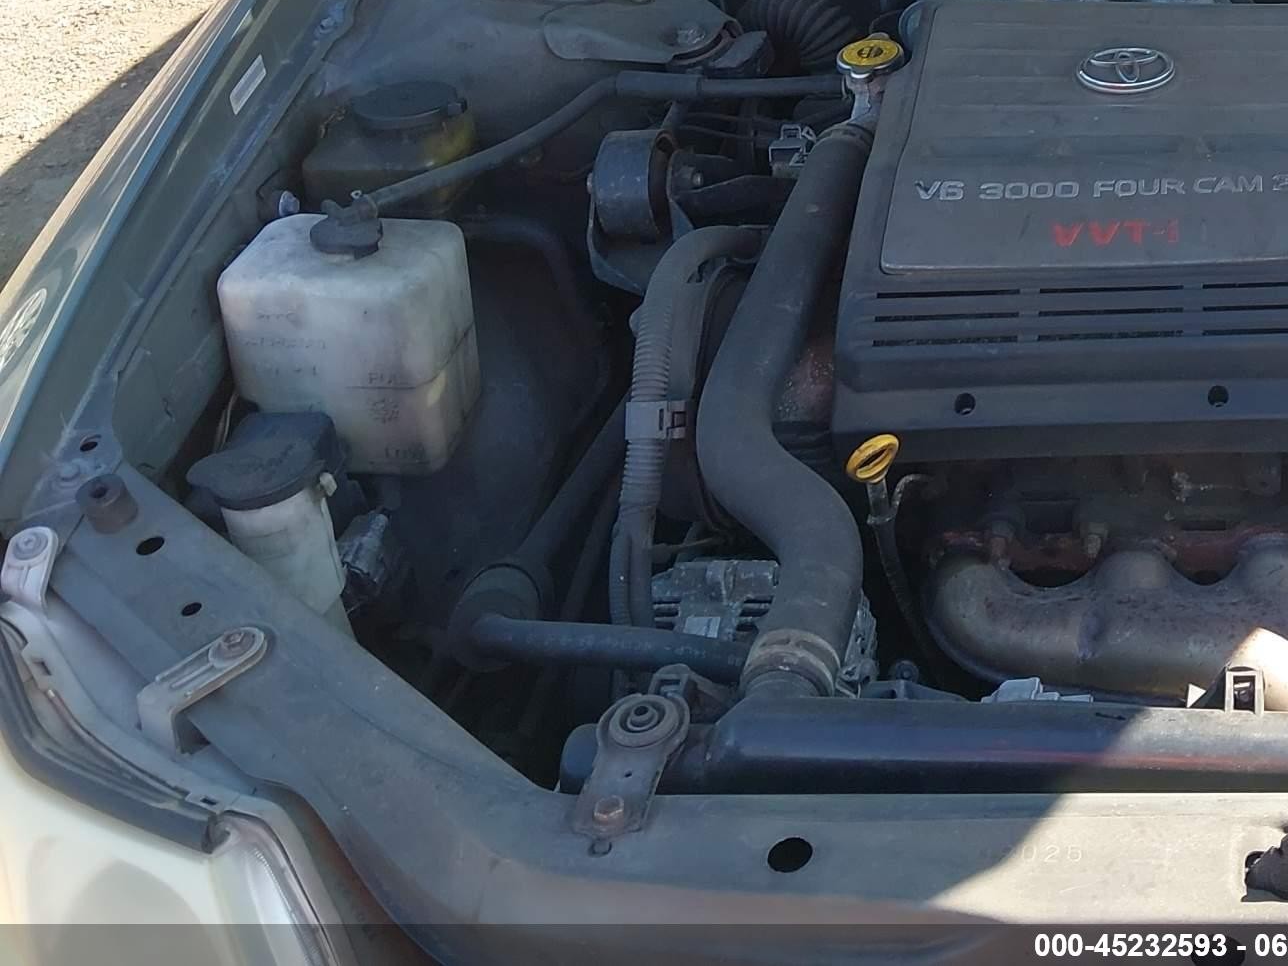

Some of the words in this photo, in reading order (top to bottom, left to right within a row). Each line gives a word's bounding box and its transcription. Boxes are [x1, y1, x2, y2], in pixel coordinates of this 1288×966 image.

[914, 180, 965, 201] V6
[978, 181, 1080, 200] 3000
[1093, 177, 1186, 198] FOUR
[1193, 174, 1263, 194] CAM
